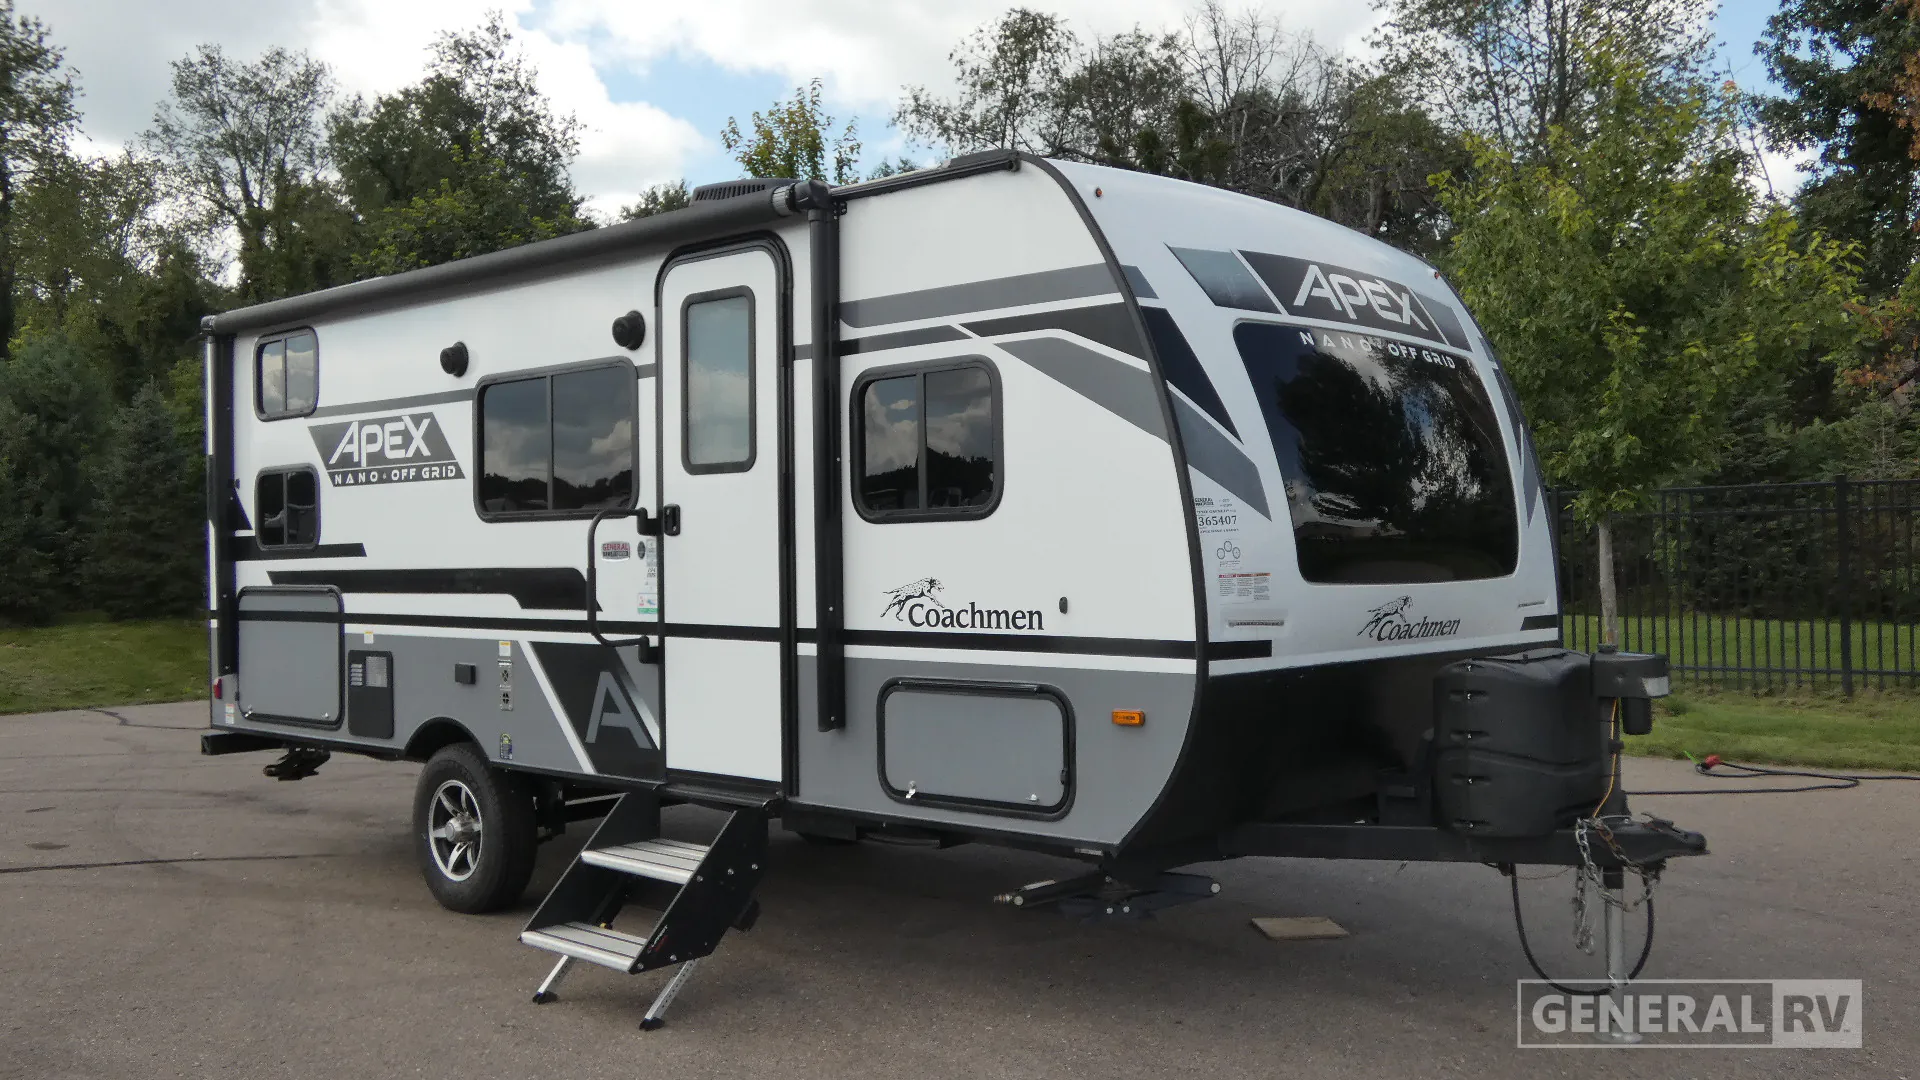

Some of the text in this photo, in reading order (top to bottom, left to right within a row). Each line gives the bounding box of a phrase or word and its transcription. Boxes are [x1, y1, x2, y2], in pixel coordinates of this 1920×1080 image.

[1299, 331, 1456, 369] NANO OFF GRID
[334, 465, 457, 485] NANO OFF GRID
[1198, 515, 1237, 527] 365407
[602, 543, 630, 551] GENERAL
[908, 601, 1045, 631] Coachmen
[1376, 615, 1461, 642] Coachmen
